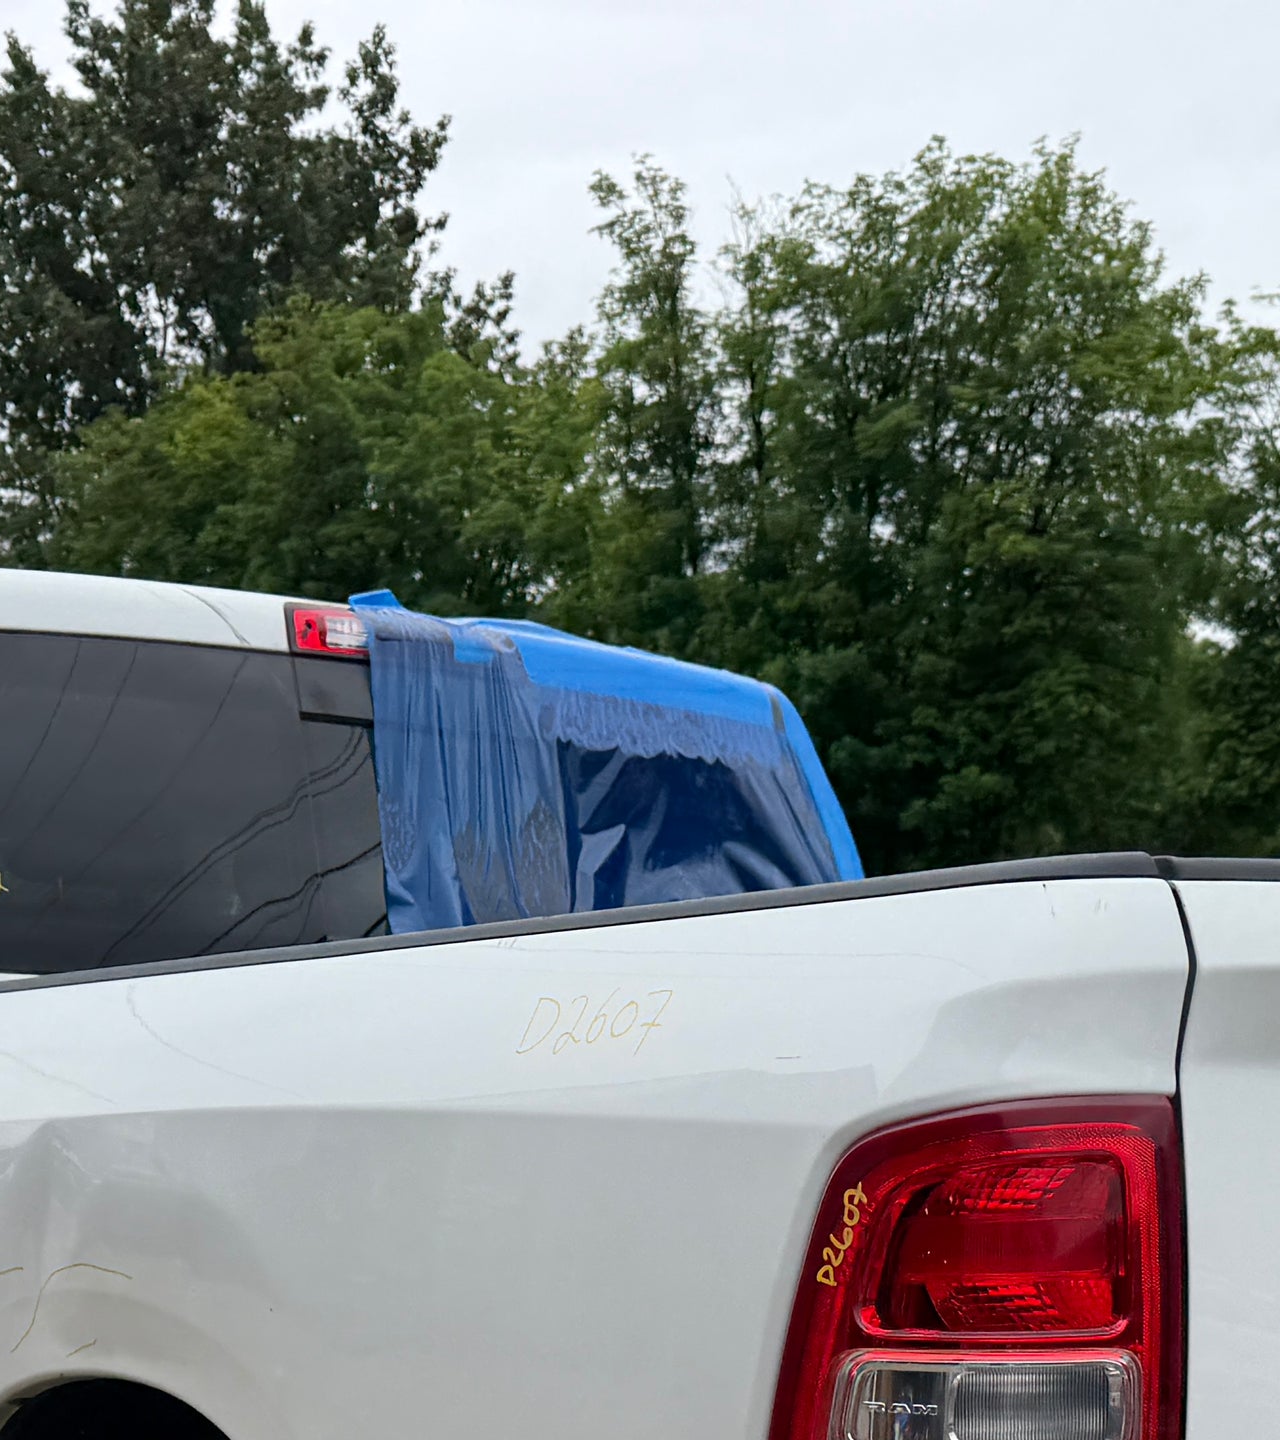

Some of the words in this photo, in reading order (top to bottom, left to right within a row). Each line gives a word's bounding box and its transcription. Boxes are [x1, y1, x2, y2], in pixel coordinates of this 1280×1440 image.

[516, 987, 672, 1056] D2607
[817, 1181, 867, 1286] D2607
[863, 1400, 938, 1416] RAM
